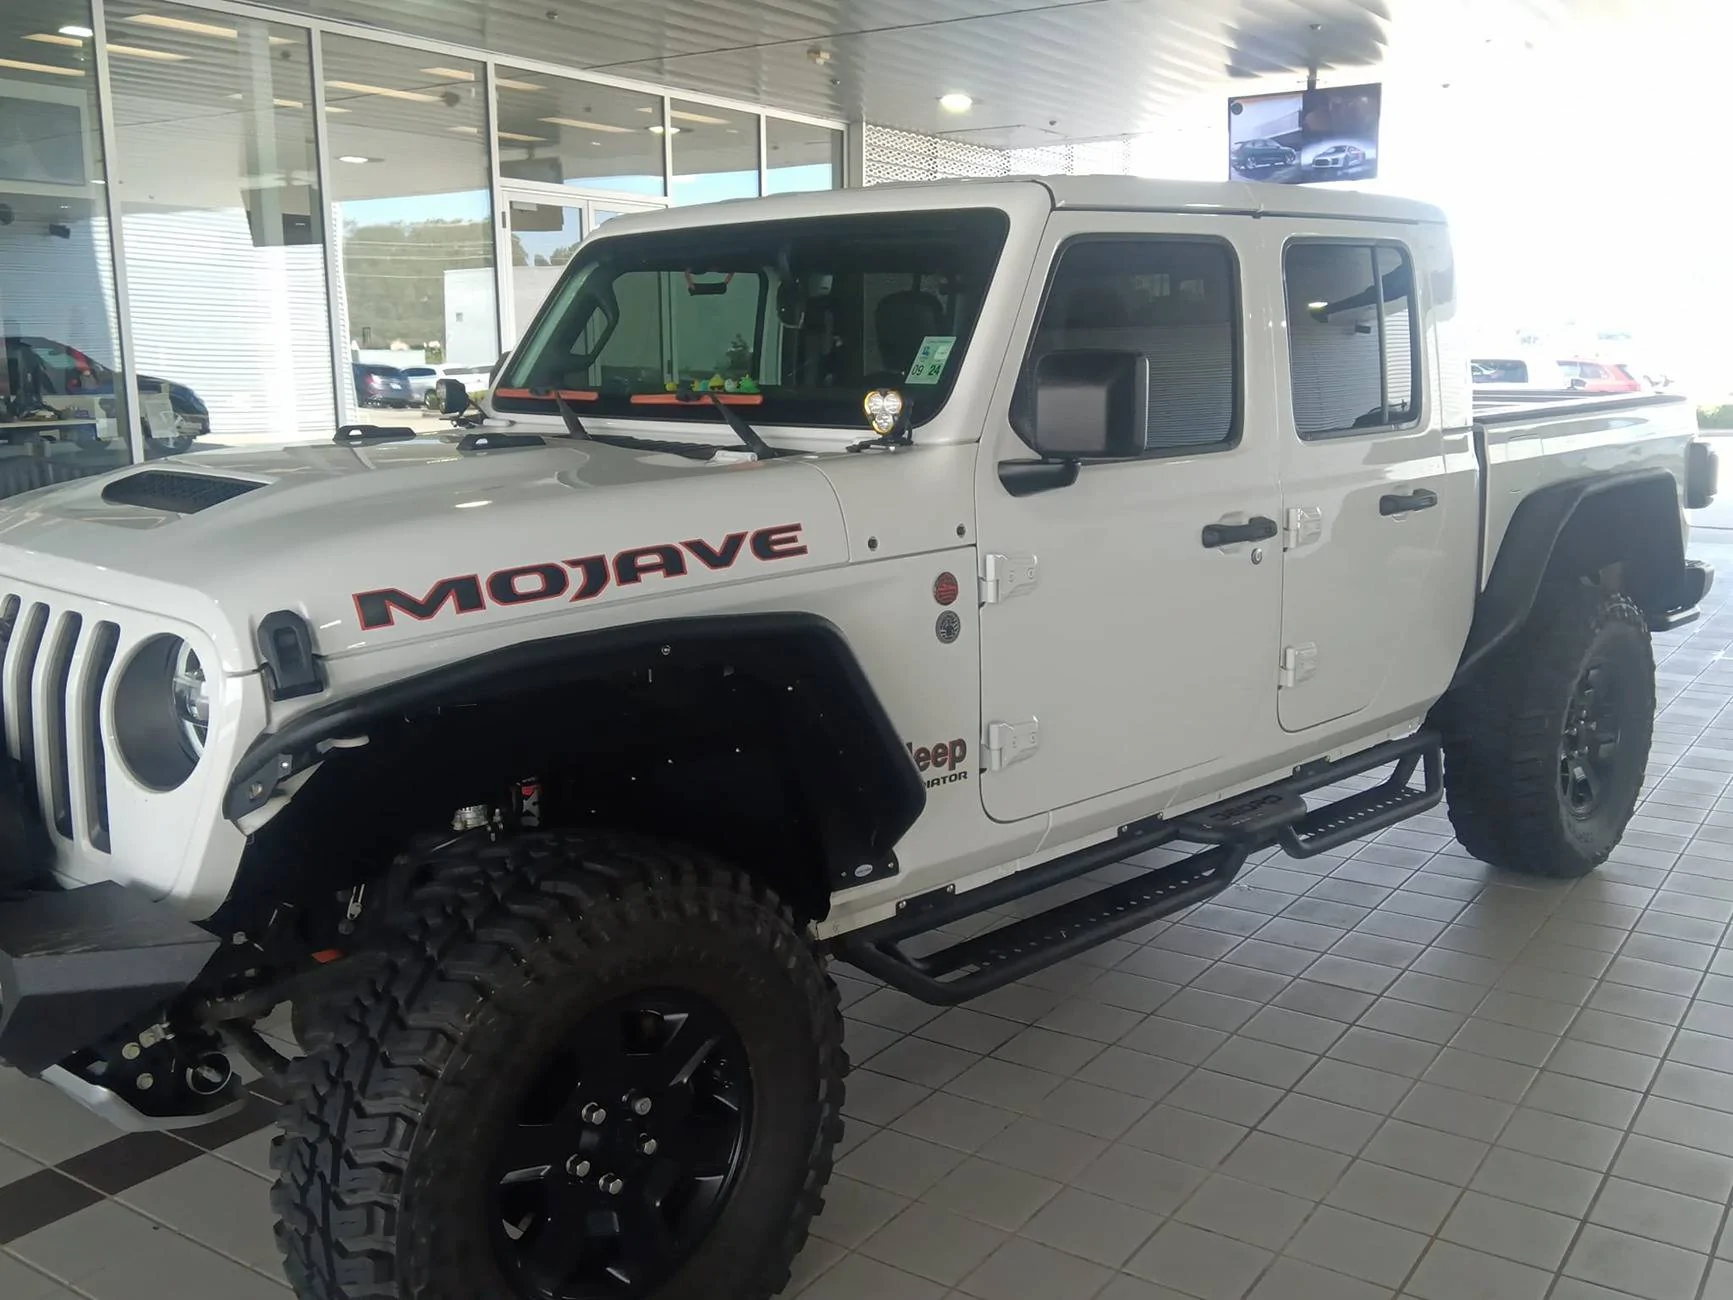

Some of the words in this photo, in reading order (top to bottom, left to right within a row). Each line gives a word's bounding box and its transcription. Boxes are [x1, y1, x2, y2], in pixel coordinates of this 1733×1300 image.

[912, 364, 924, 376] 09
[928, 364, 941, 376] 24
[352, 522, 808, 631] MOJAVE
[925, 771, 968, 788] IATOR
